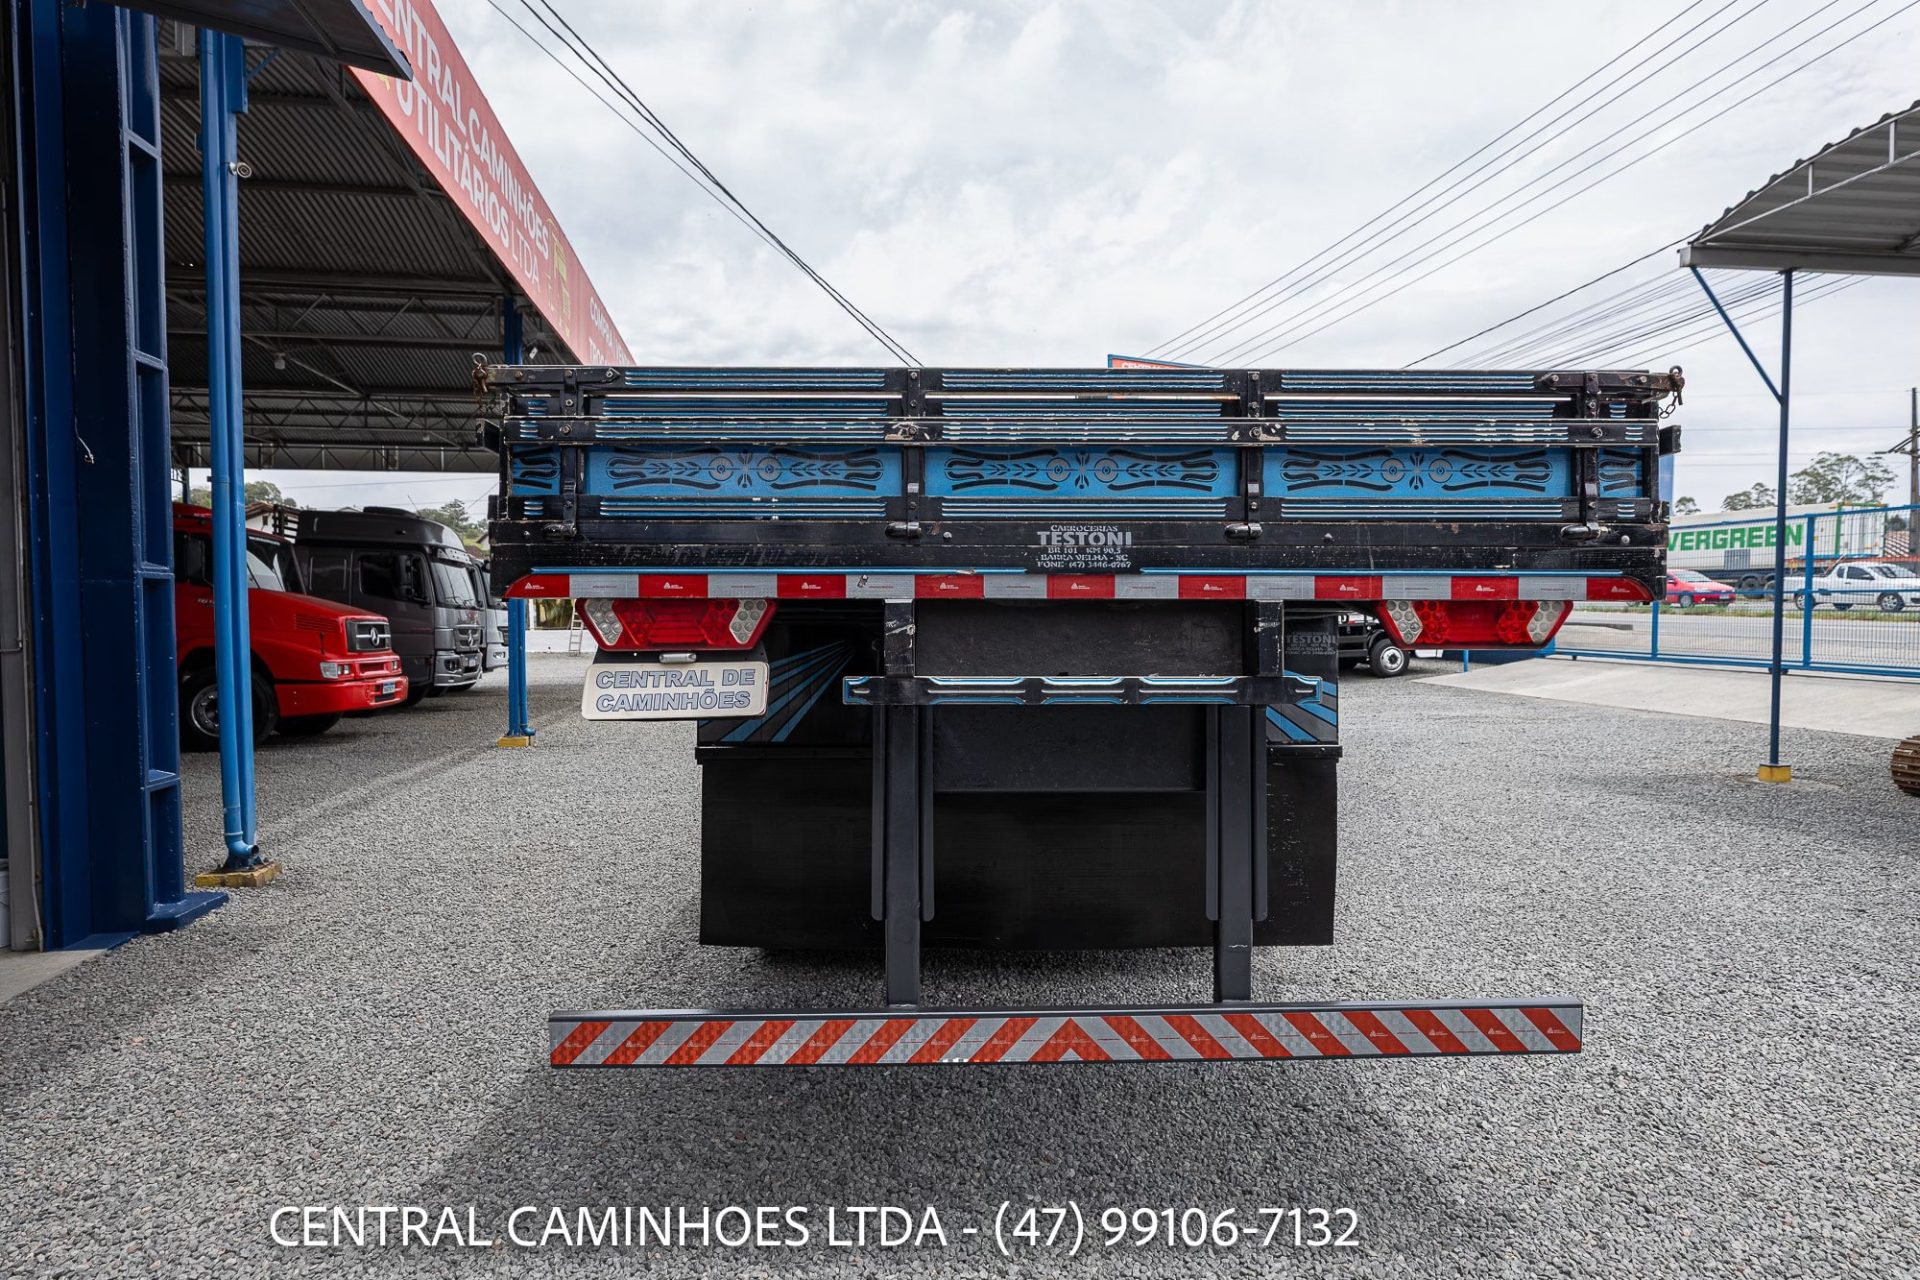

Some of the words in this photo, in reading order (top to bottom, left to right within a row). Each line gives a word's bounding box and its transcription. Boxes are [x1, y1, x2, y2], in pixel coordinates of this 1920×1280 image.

[395, 76, 511, 250] UTILITÁRIOS
[511, 220, 542, 293] LTDA
[468, 107, 550, 260] CAMINHÕES
[1037, 531, 1133, 546] TESTONI
[1069, 561, 1085, 569] (47)
[596, 669, 715, 689] CENTRAL
[721, 668, 756, 686] DE
[596, 688, 751, 712] CAMINHÕES
